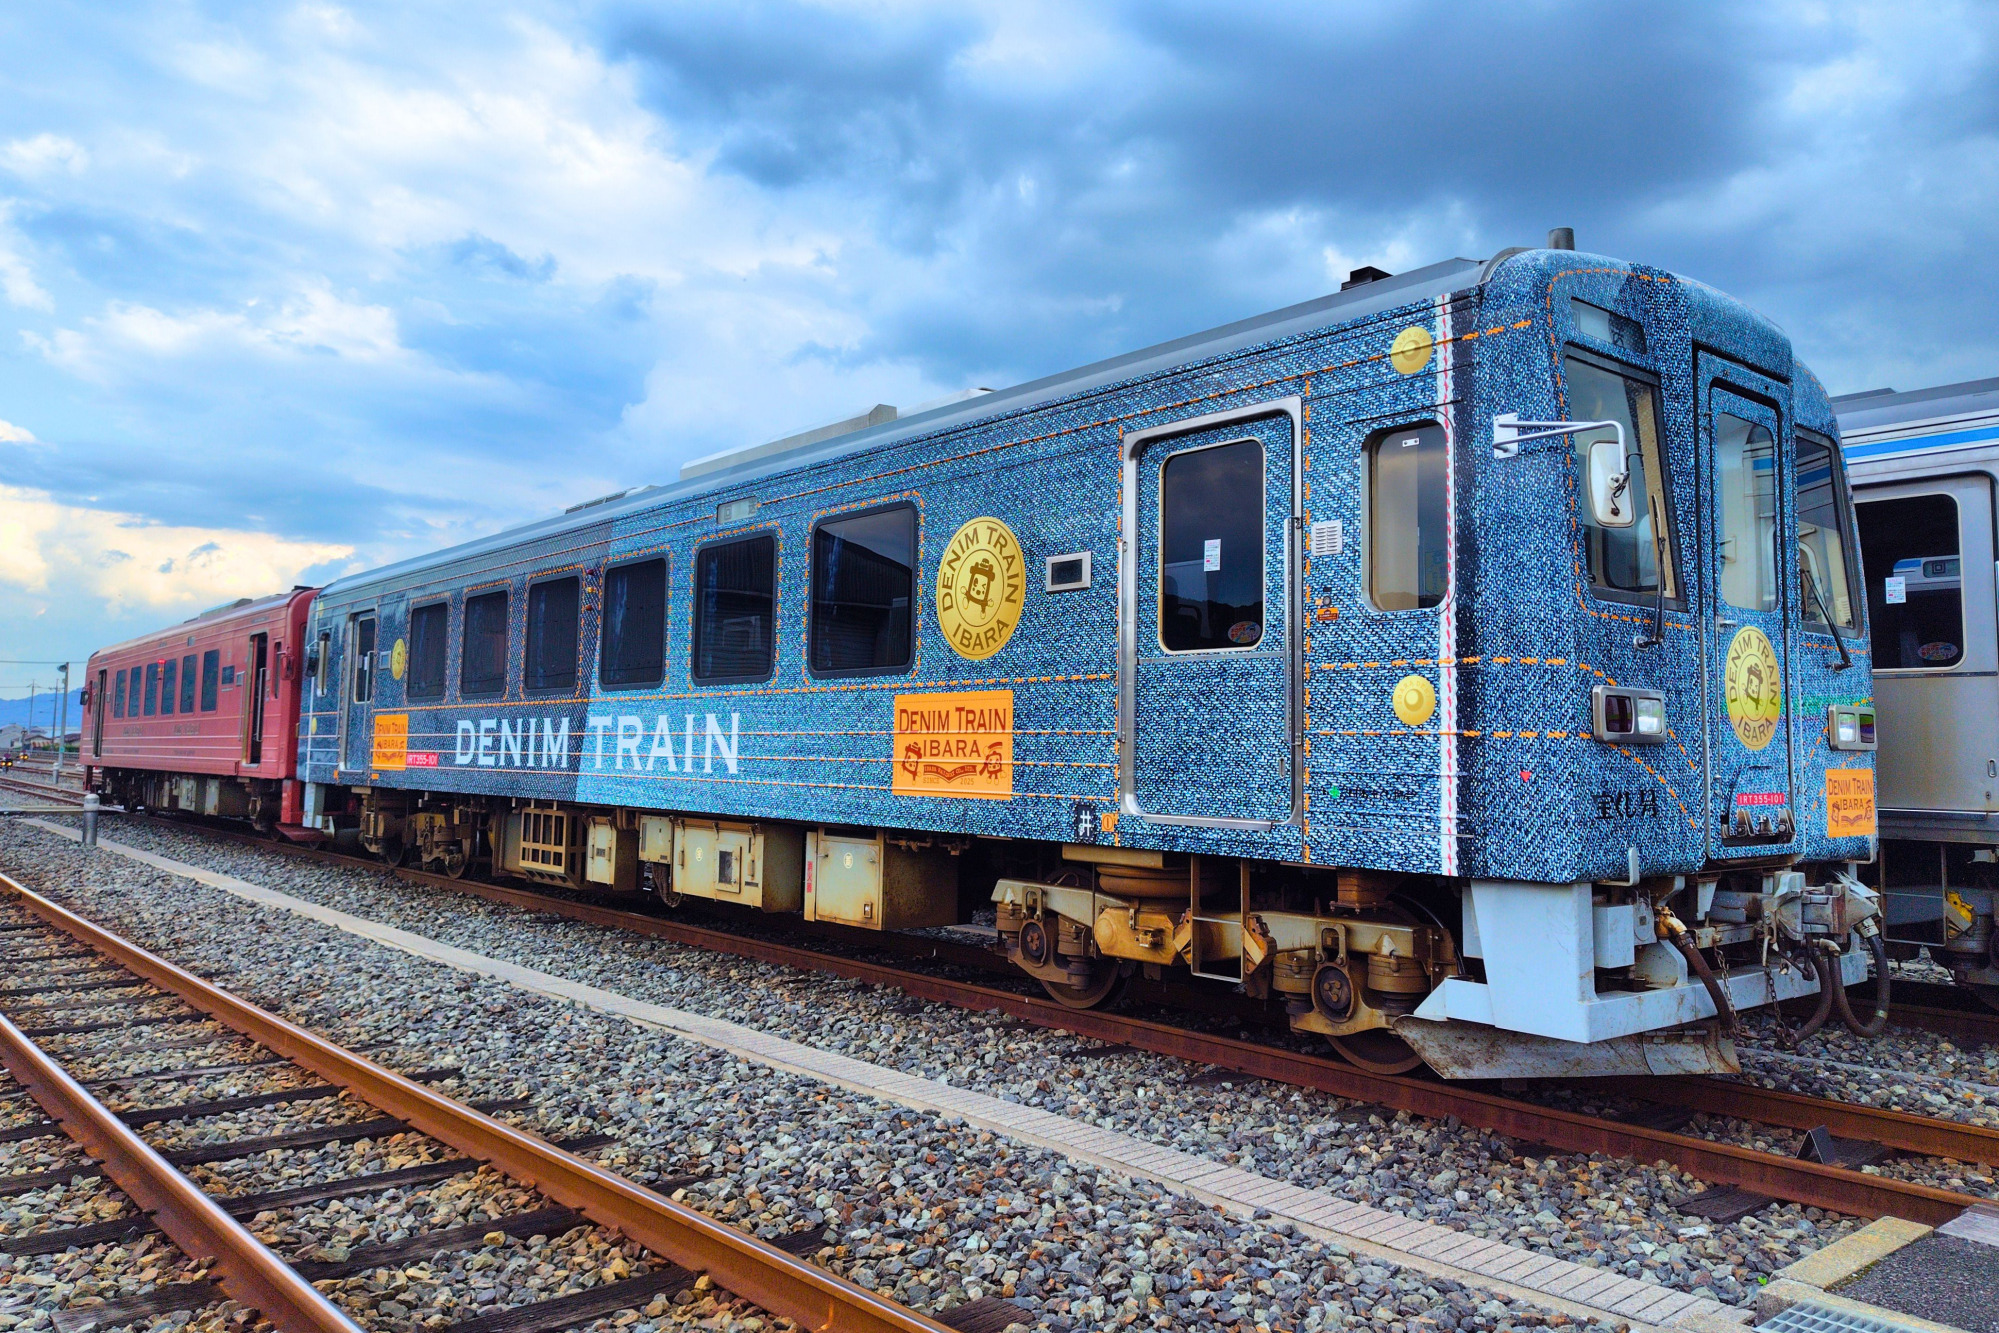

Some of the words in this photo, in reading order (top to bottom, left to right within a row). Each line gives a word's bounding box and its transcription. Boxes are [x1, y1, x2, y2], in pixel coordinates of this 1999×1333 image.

[942, 526, 980, 612] DENIM
[986, 525, 1019, 604] TRAIN
[952, 618, 1010, 651] IBARA
[1728, 634, 1752, 704] DENIM
[1756, 636, 1777, 707] TRAIN
[899, 709, 950, 733] DENIM
[955, 707, 1006, 733] TRAIN
[1738, 716, 1773, 742] IBARA
[455, 717, 570, 769] DENIM
[589, 713, 740, 774] TRAIN
[923, 739, 981, 757] IBARA
[1739, 794, 1783, 804] IRT355-101
[1828, 778, 1850, 796] DENIM
[1852, 777, 1873, 795] TRAIN
[1840, 798, 1864, 811] IBARA
